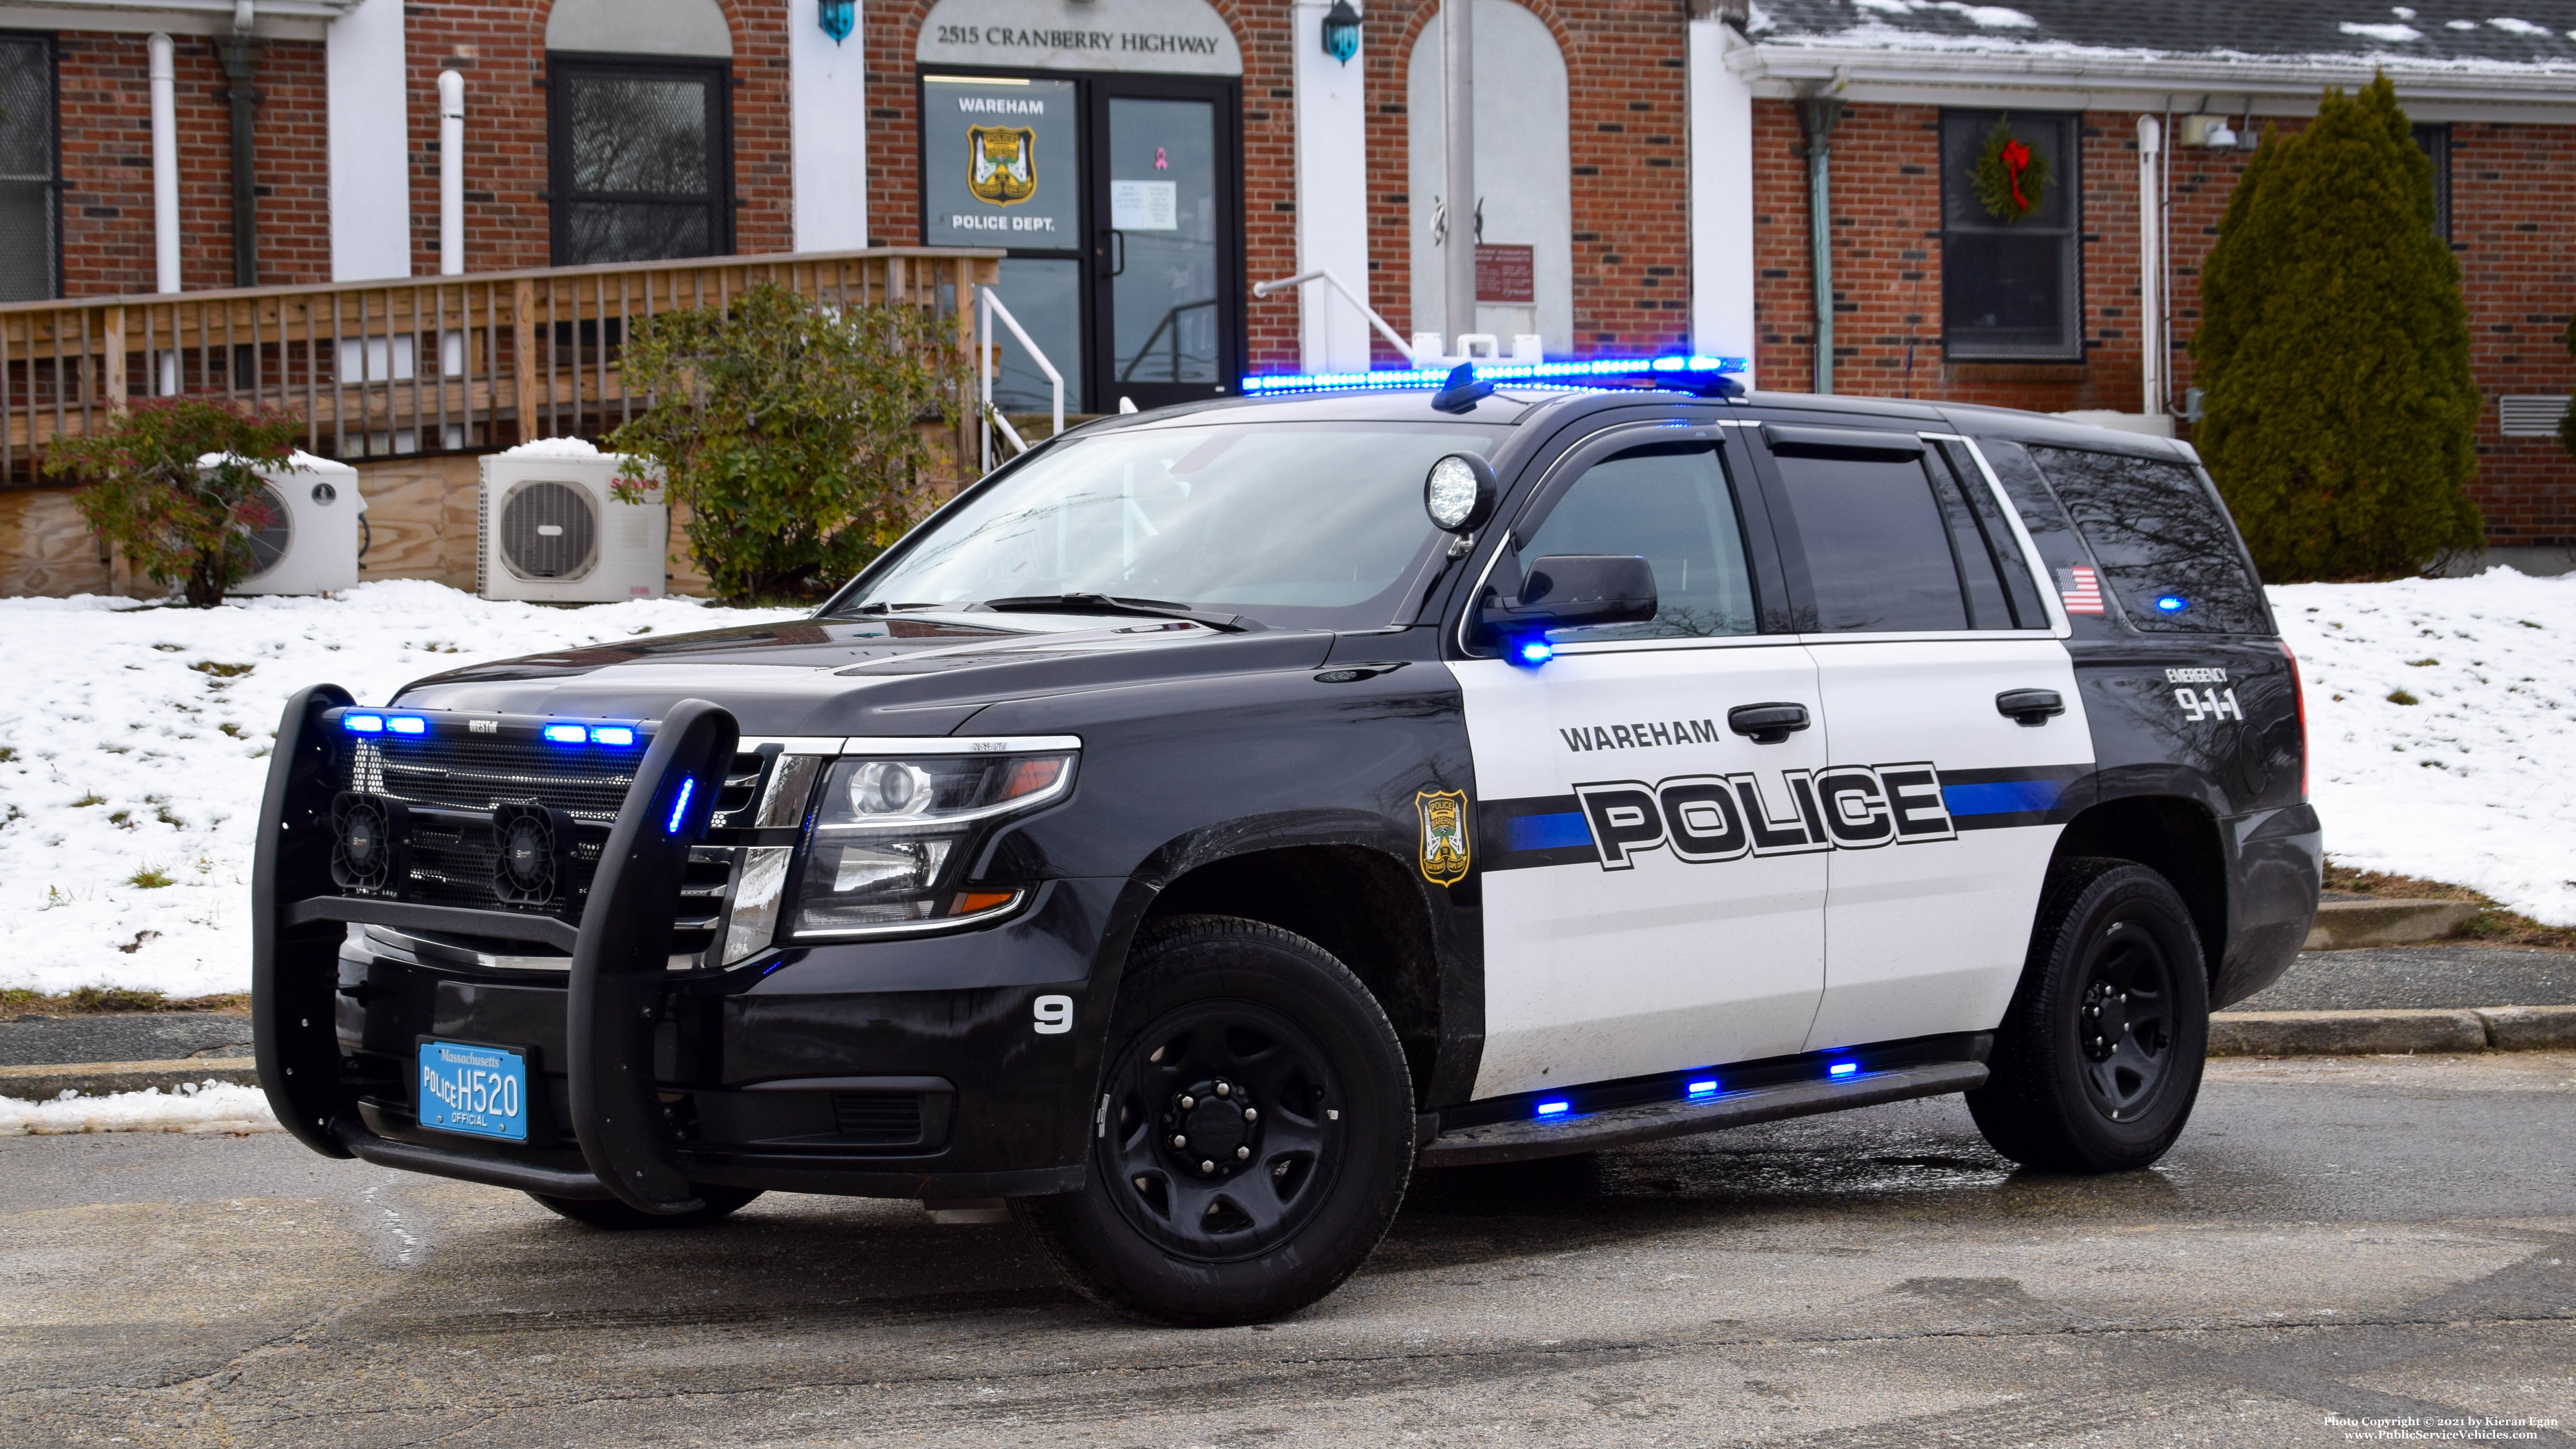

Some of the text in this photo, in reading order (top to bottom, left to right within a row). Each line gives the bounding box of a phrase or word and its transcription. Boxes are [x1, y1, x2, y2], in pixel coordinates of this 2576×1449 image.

[938, 25, 1219, 55] 2515 CRANBERRY HIGHWAY
[958, 97, 1044, 115] WAREHAM
[952, 215, 1055, 232] POLICE DEPT.
[2164, 668, 2228, 683] EMERGENCY
[2174, 688, 2243, 721] 9-1-1
[1559, 719, 1720, 753] WAREHAM
[1431, 801, 1452, 811] POLICE
[1431, 816, 1455, 828] WAREHAM
[1571, 760, 1959, 873] POLICE
[1034, 995, 1073, 1034] 9
[441, 1048, 500, 1068] Massachusetts
[424, 1065, 518, 1117] POLICE H520
[452, 1113, 488, 1127] OFFICIAL
